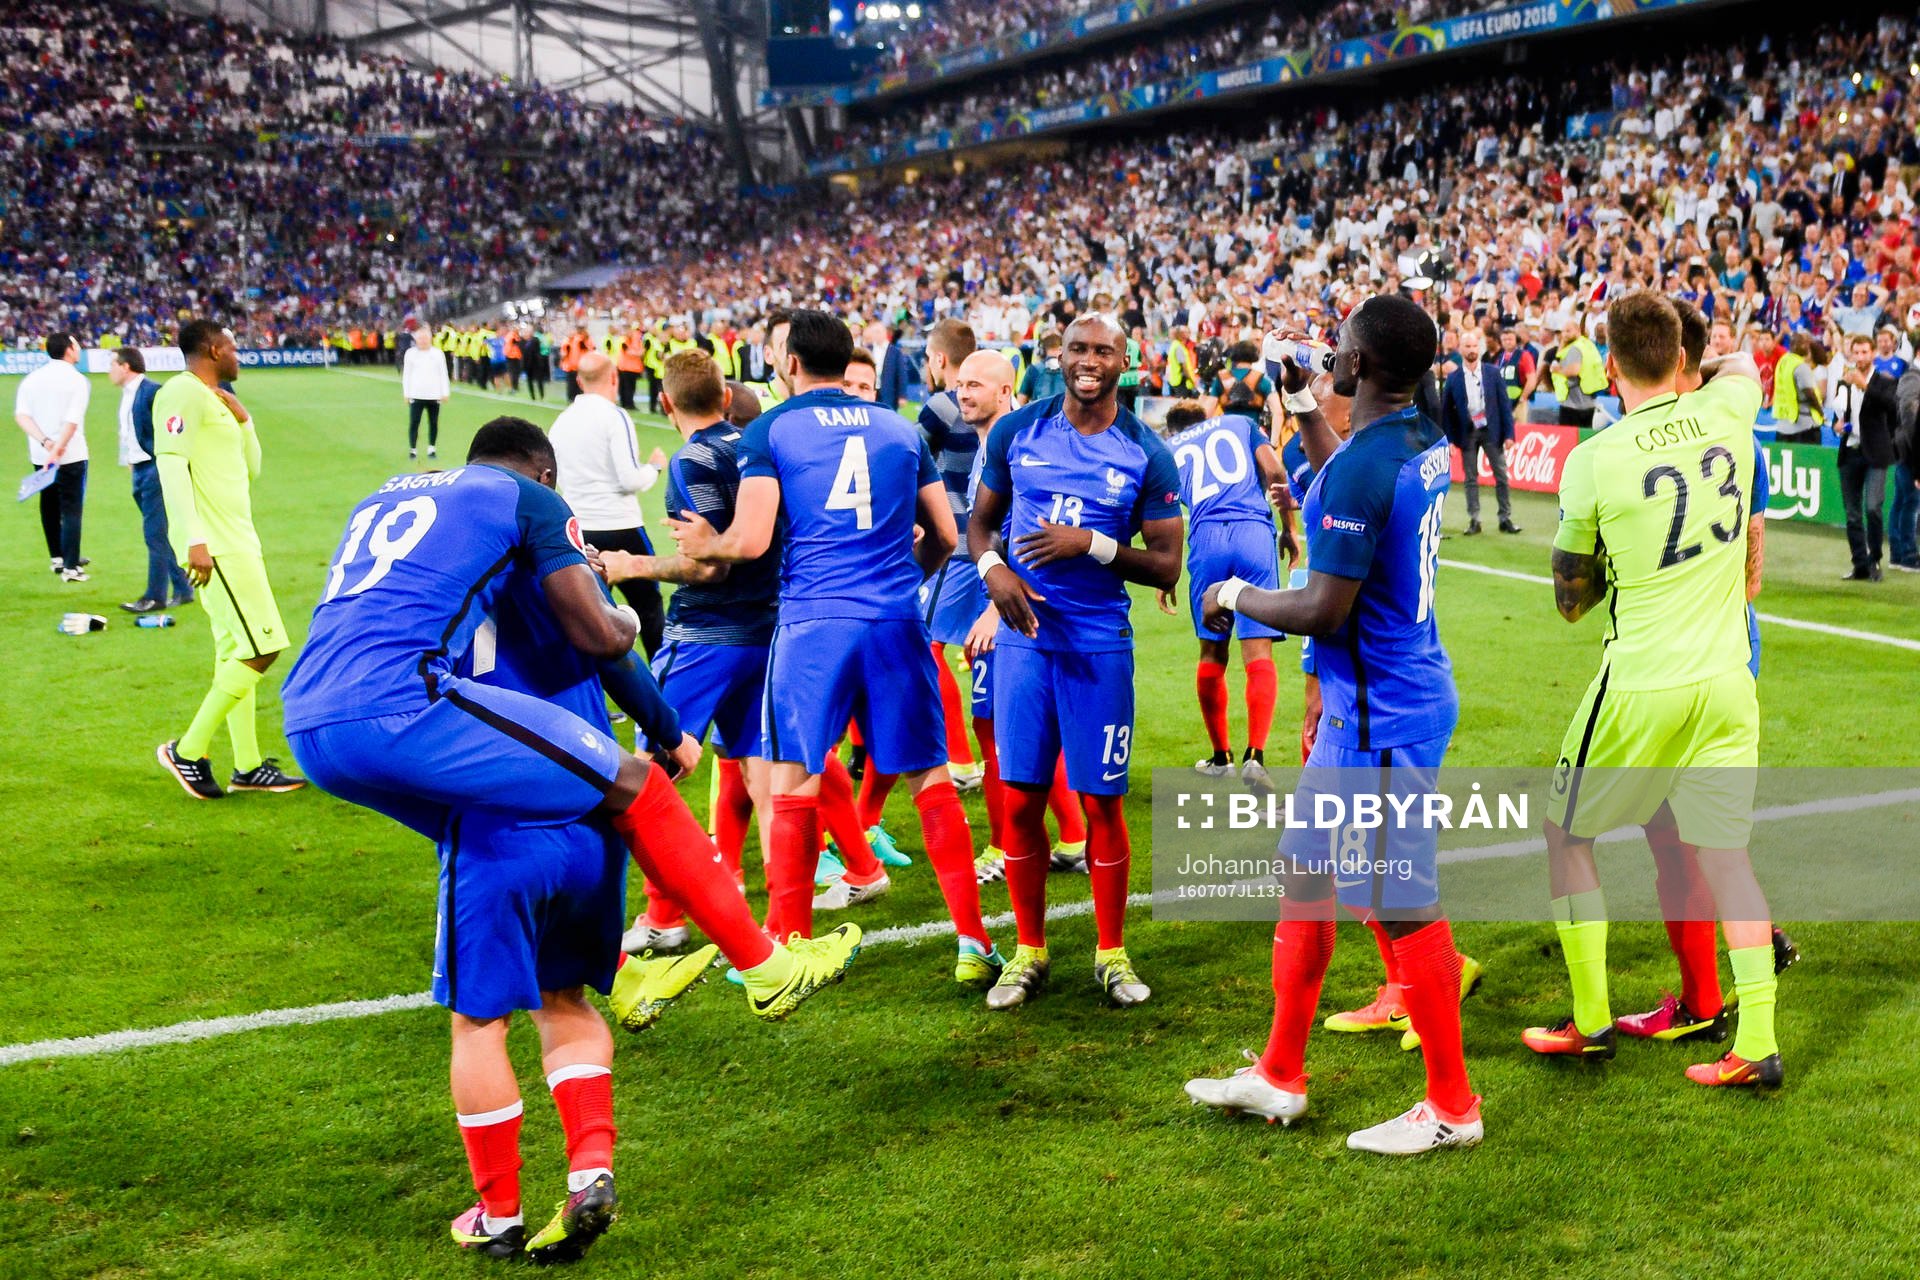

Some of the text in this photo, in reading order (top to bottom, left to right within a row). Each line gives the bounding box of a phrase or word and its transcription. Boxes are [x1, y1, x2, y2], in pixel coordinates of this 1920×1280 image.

[1451, 3, 1557, 42] UEFA EURO 2016
[233, 350, 338, 365] NO TO RACISM
[813, 407, 870, 426] RAMI
[1171, 418, 1222, 446] COMAN
[1635, 417, 1708, 453] COSTIL
[379, 468, 466, 494] SAGNA
[825, 435, 873, 530] 4
[1174, 429, 1247, 506] 20
[1050, 493, 1083, 528] 13
[1333, 518, 1366, 532] RESPECT
[1641, 446, 1744, 570] 23
[325, 495, 438, 602] 19
[1102, 724, 1130, 765] 13
[1555, 756, 1571, 795] 3
